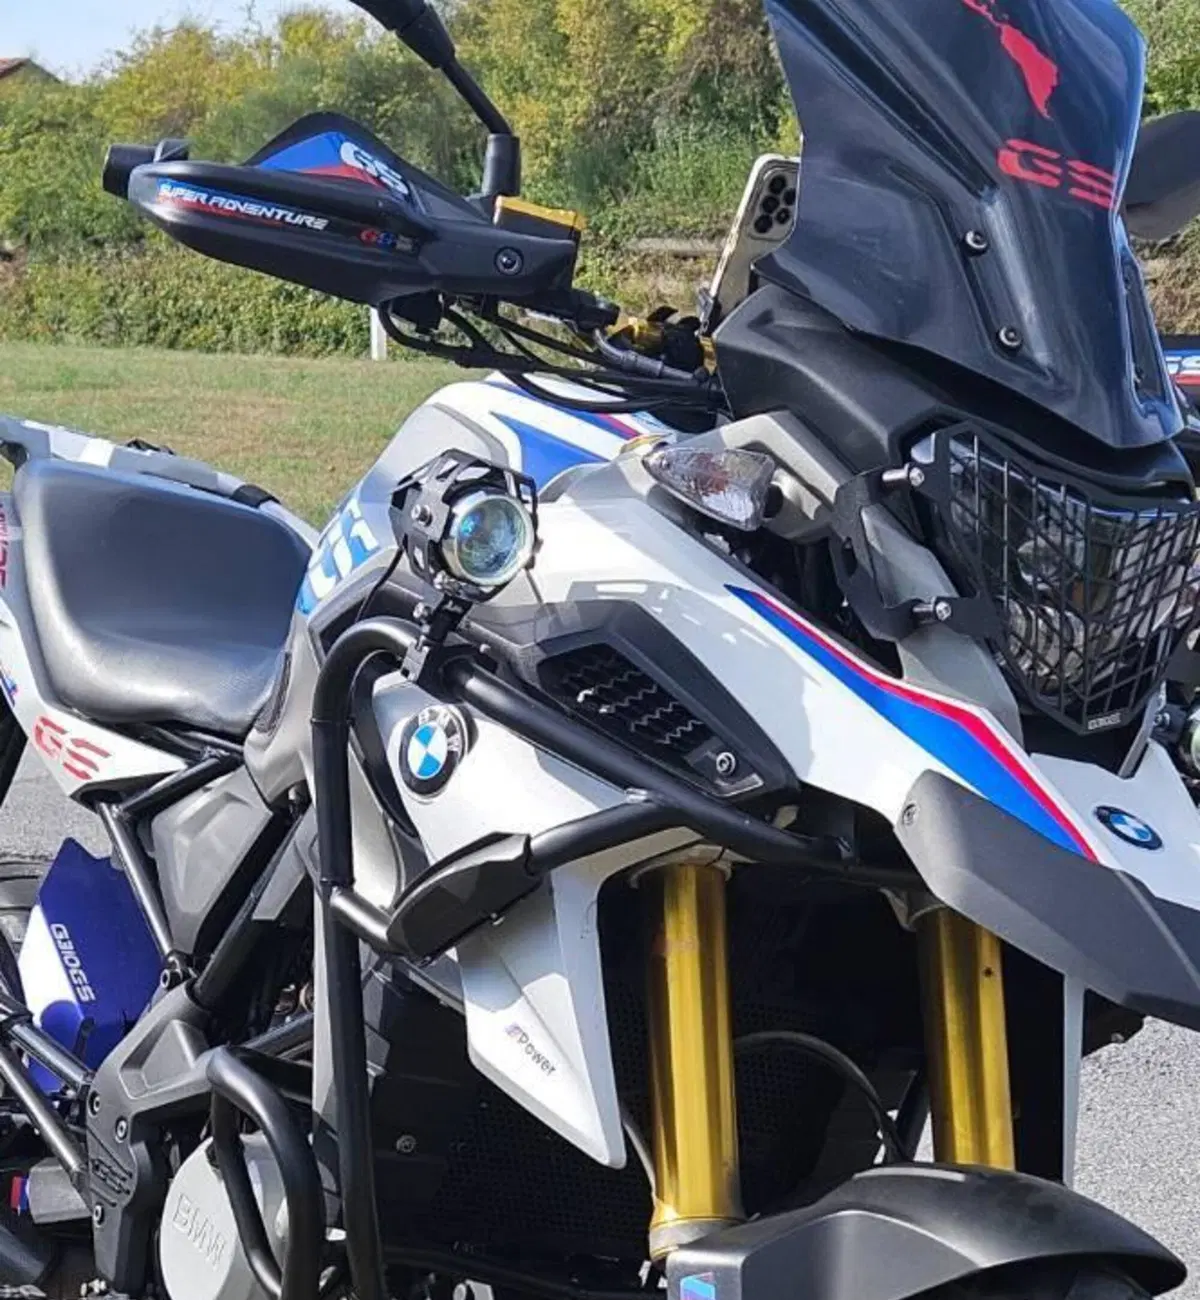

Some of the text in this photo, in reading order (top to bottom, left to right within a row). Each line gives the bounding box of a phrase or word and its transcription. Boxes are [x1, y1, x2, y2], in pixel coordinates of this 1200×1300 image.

[340, 141, 409, 196] GS
[997, 138, 1118, 210] GS
[159, 183, 330, 231] SUPER ADVENTURE
[34, 716, 112, 780] GS
[49, 923, 97, 1003] G310GS
[172, 1193, 227, 1268] BMW
